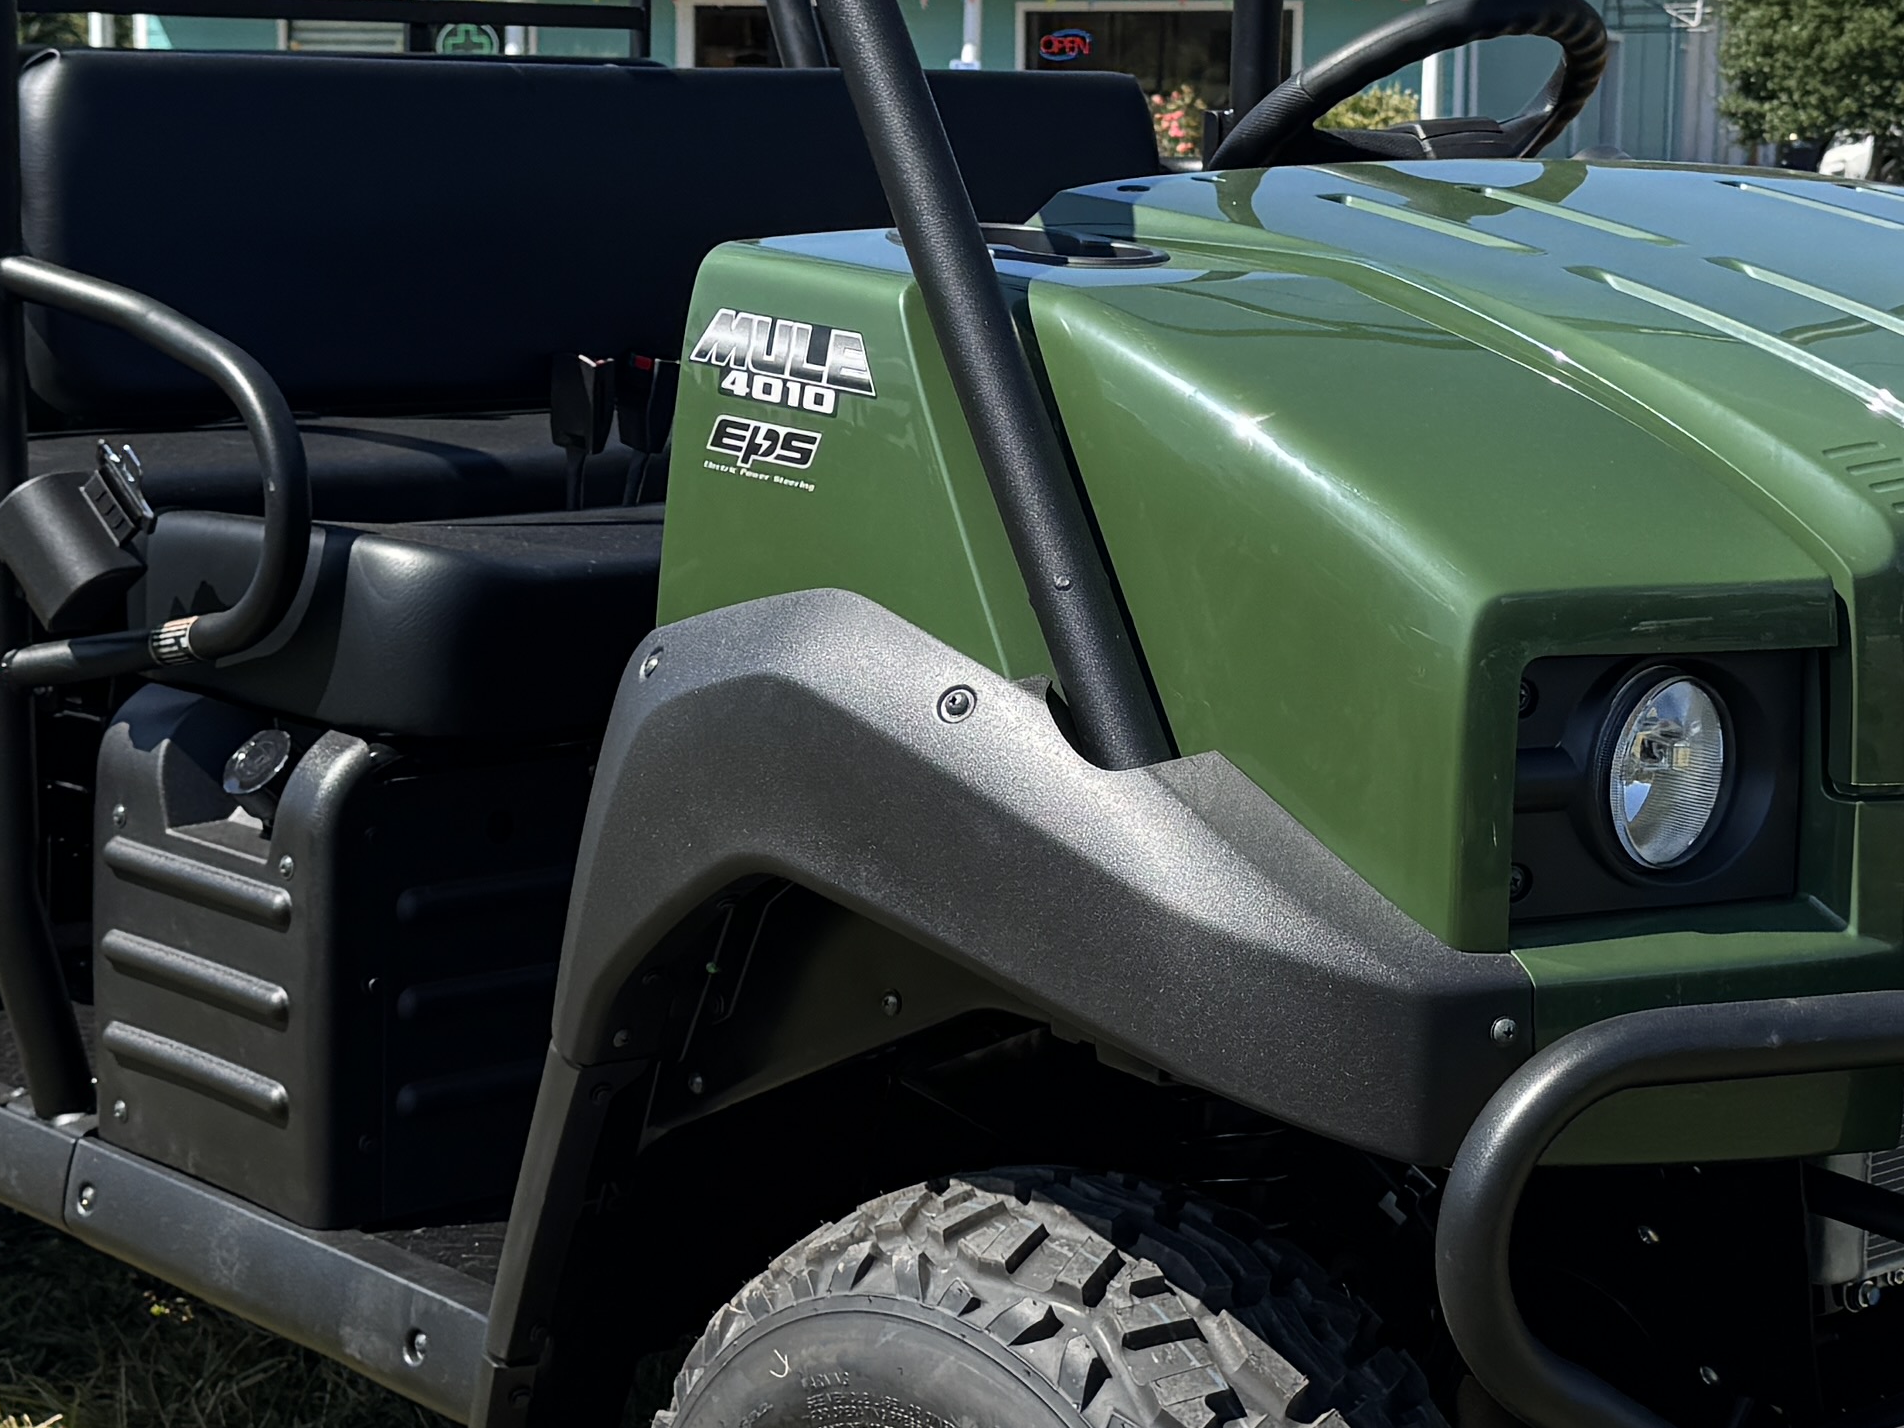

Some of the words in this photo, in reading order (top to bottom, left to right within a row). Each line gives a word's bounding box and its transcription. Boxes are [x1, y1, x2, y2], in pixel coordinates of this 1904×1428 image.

[1039, 34, 1092, 56] OPEN
[690, 308, 877, 397] MULE
[721, 370, 836, 415] 4010
